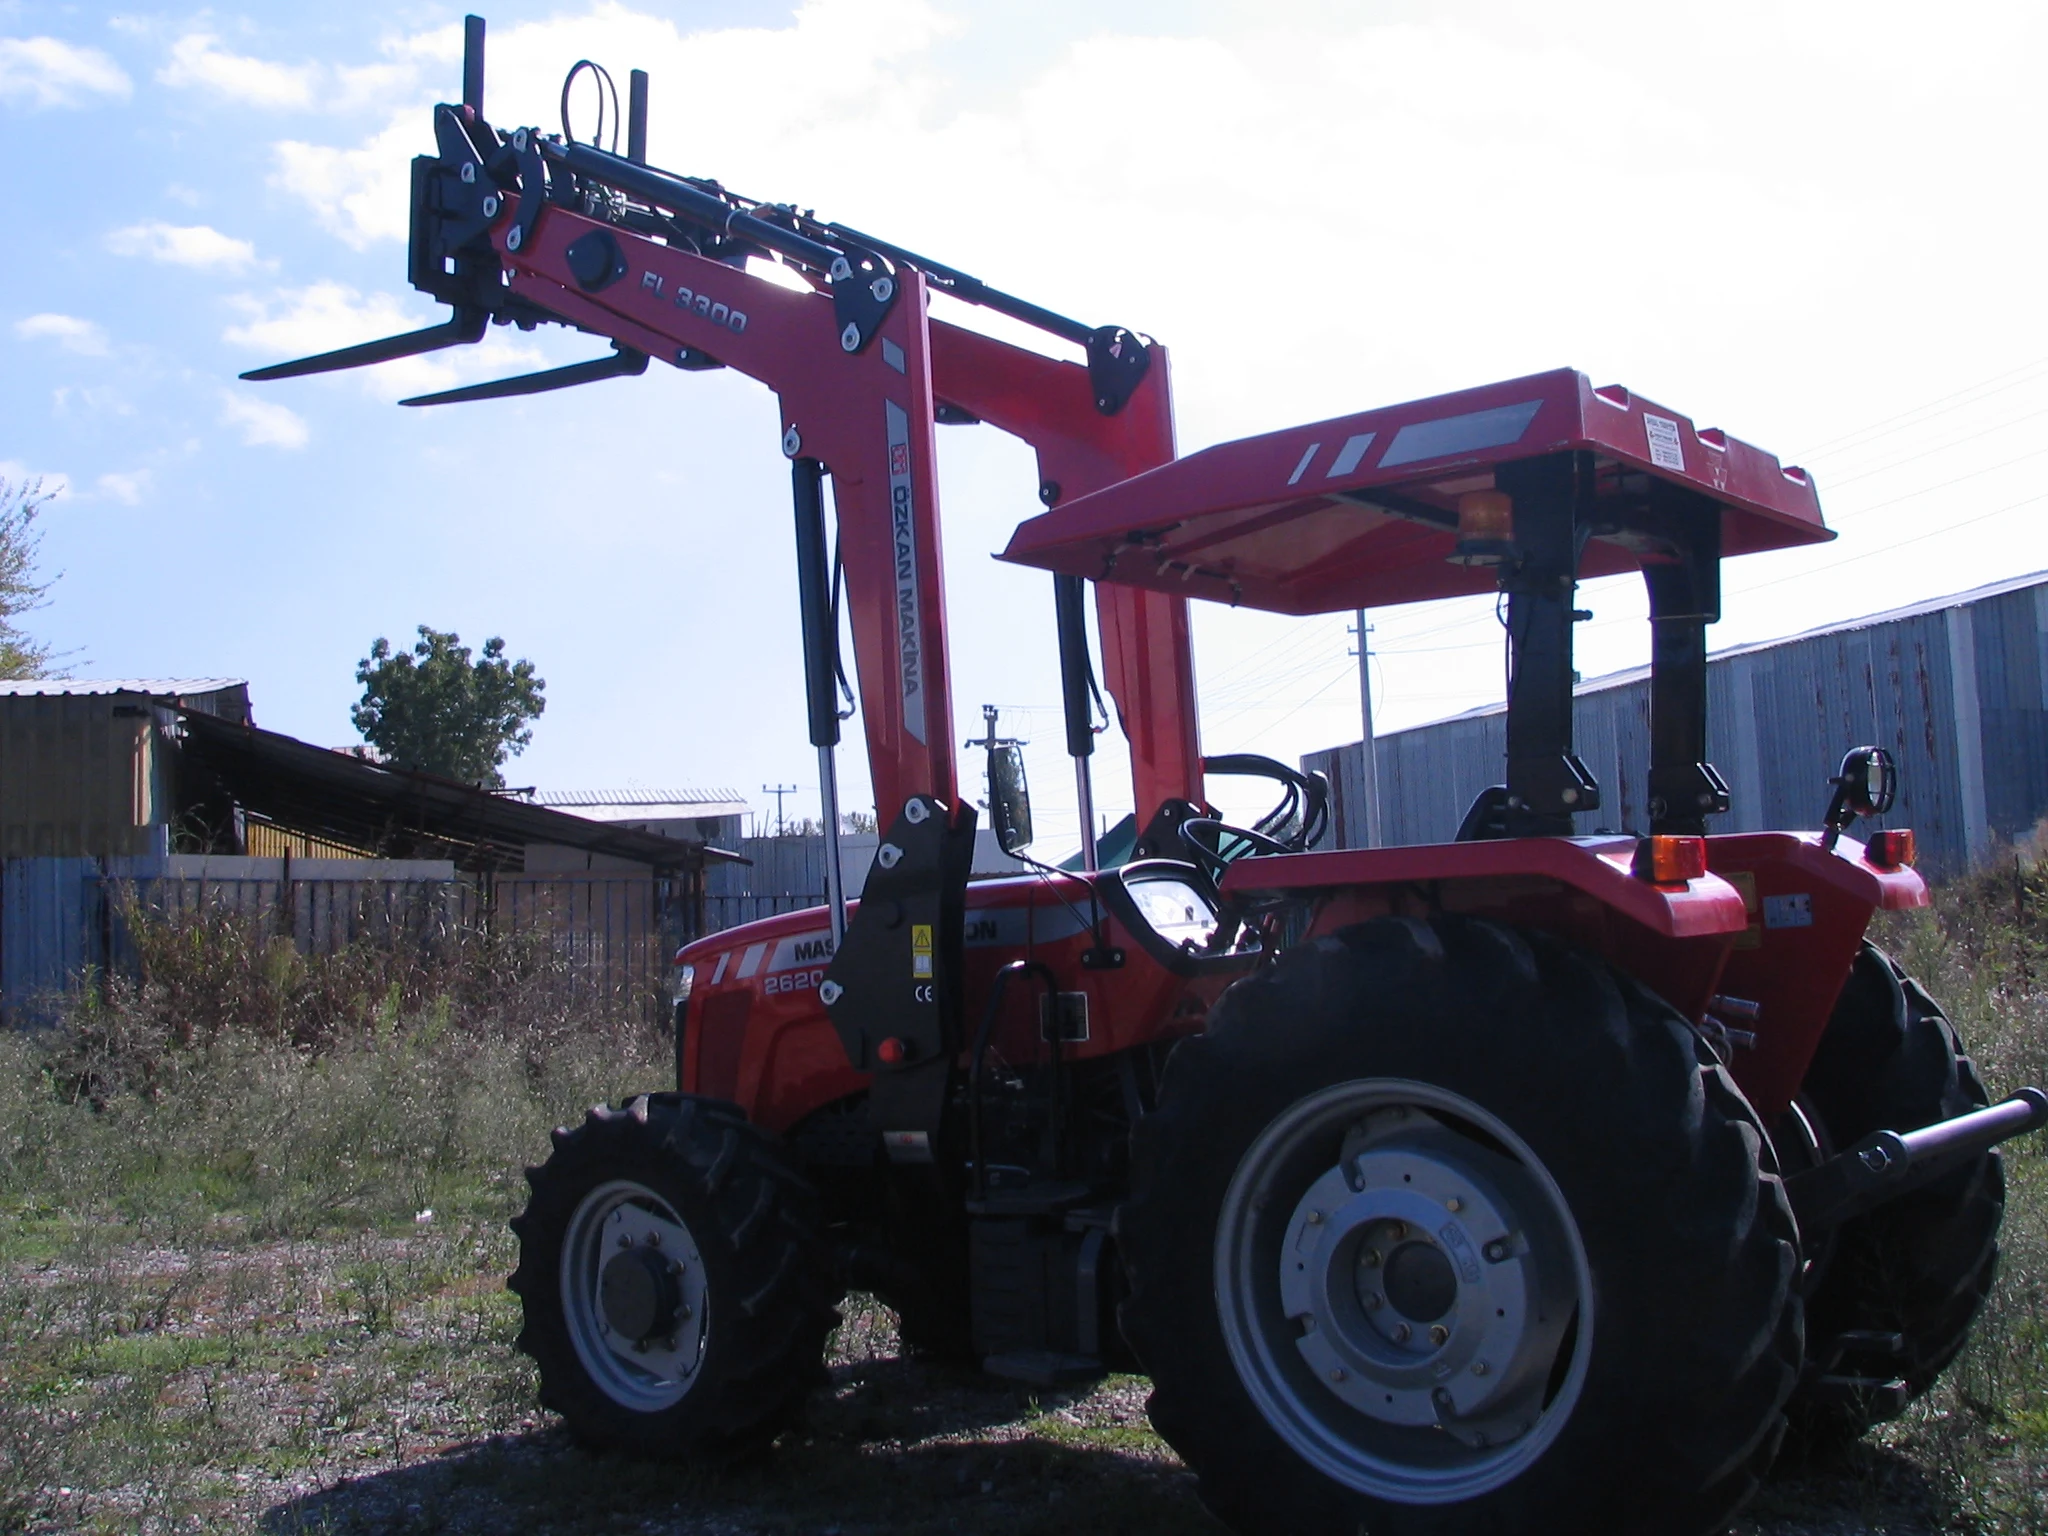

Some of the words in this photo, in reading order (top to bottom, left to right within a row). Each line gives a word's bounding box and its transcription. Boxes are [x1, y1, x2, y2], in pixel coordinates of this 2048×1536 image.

[641, 270, 665, 299] FL
[674, 286, 748, 335] 3300
[893, 485, 912, 581] ÖZKAN
[764, 969, 824, 996] 2620
[914, 985, 933, 1003] CE
